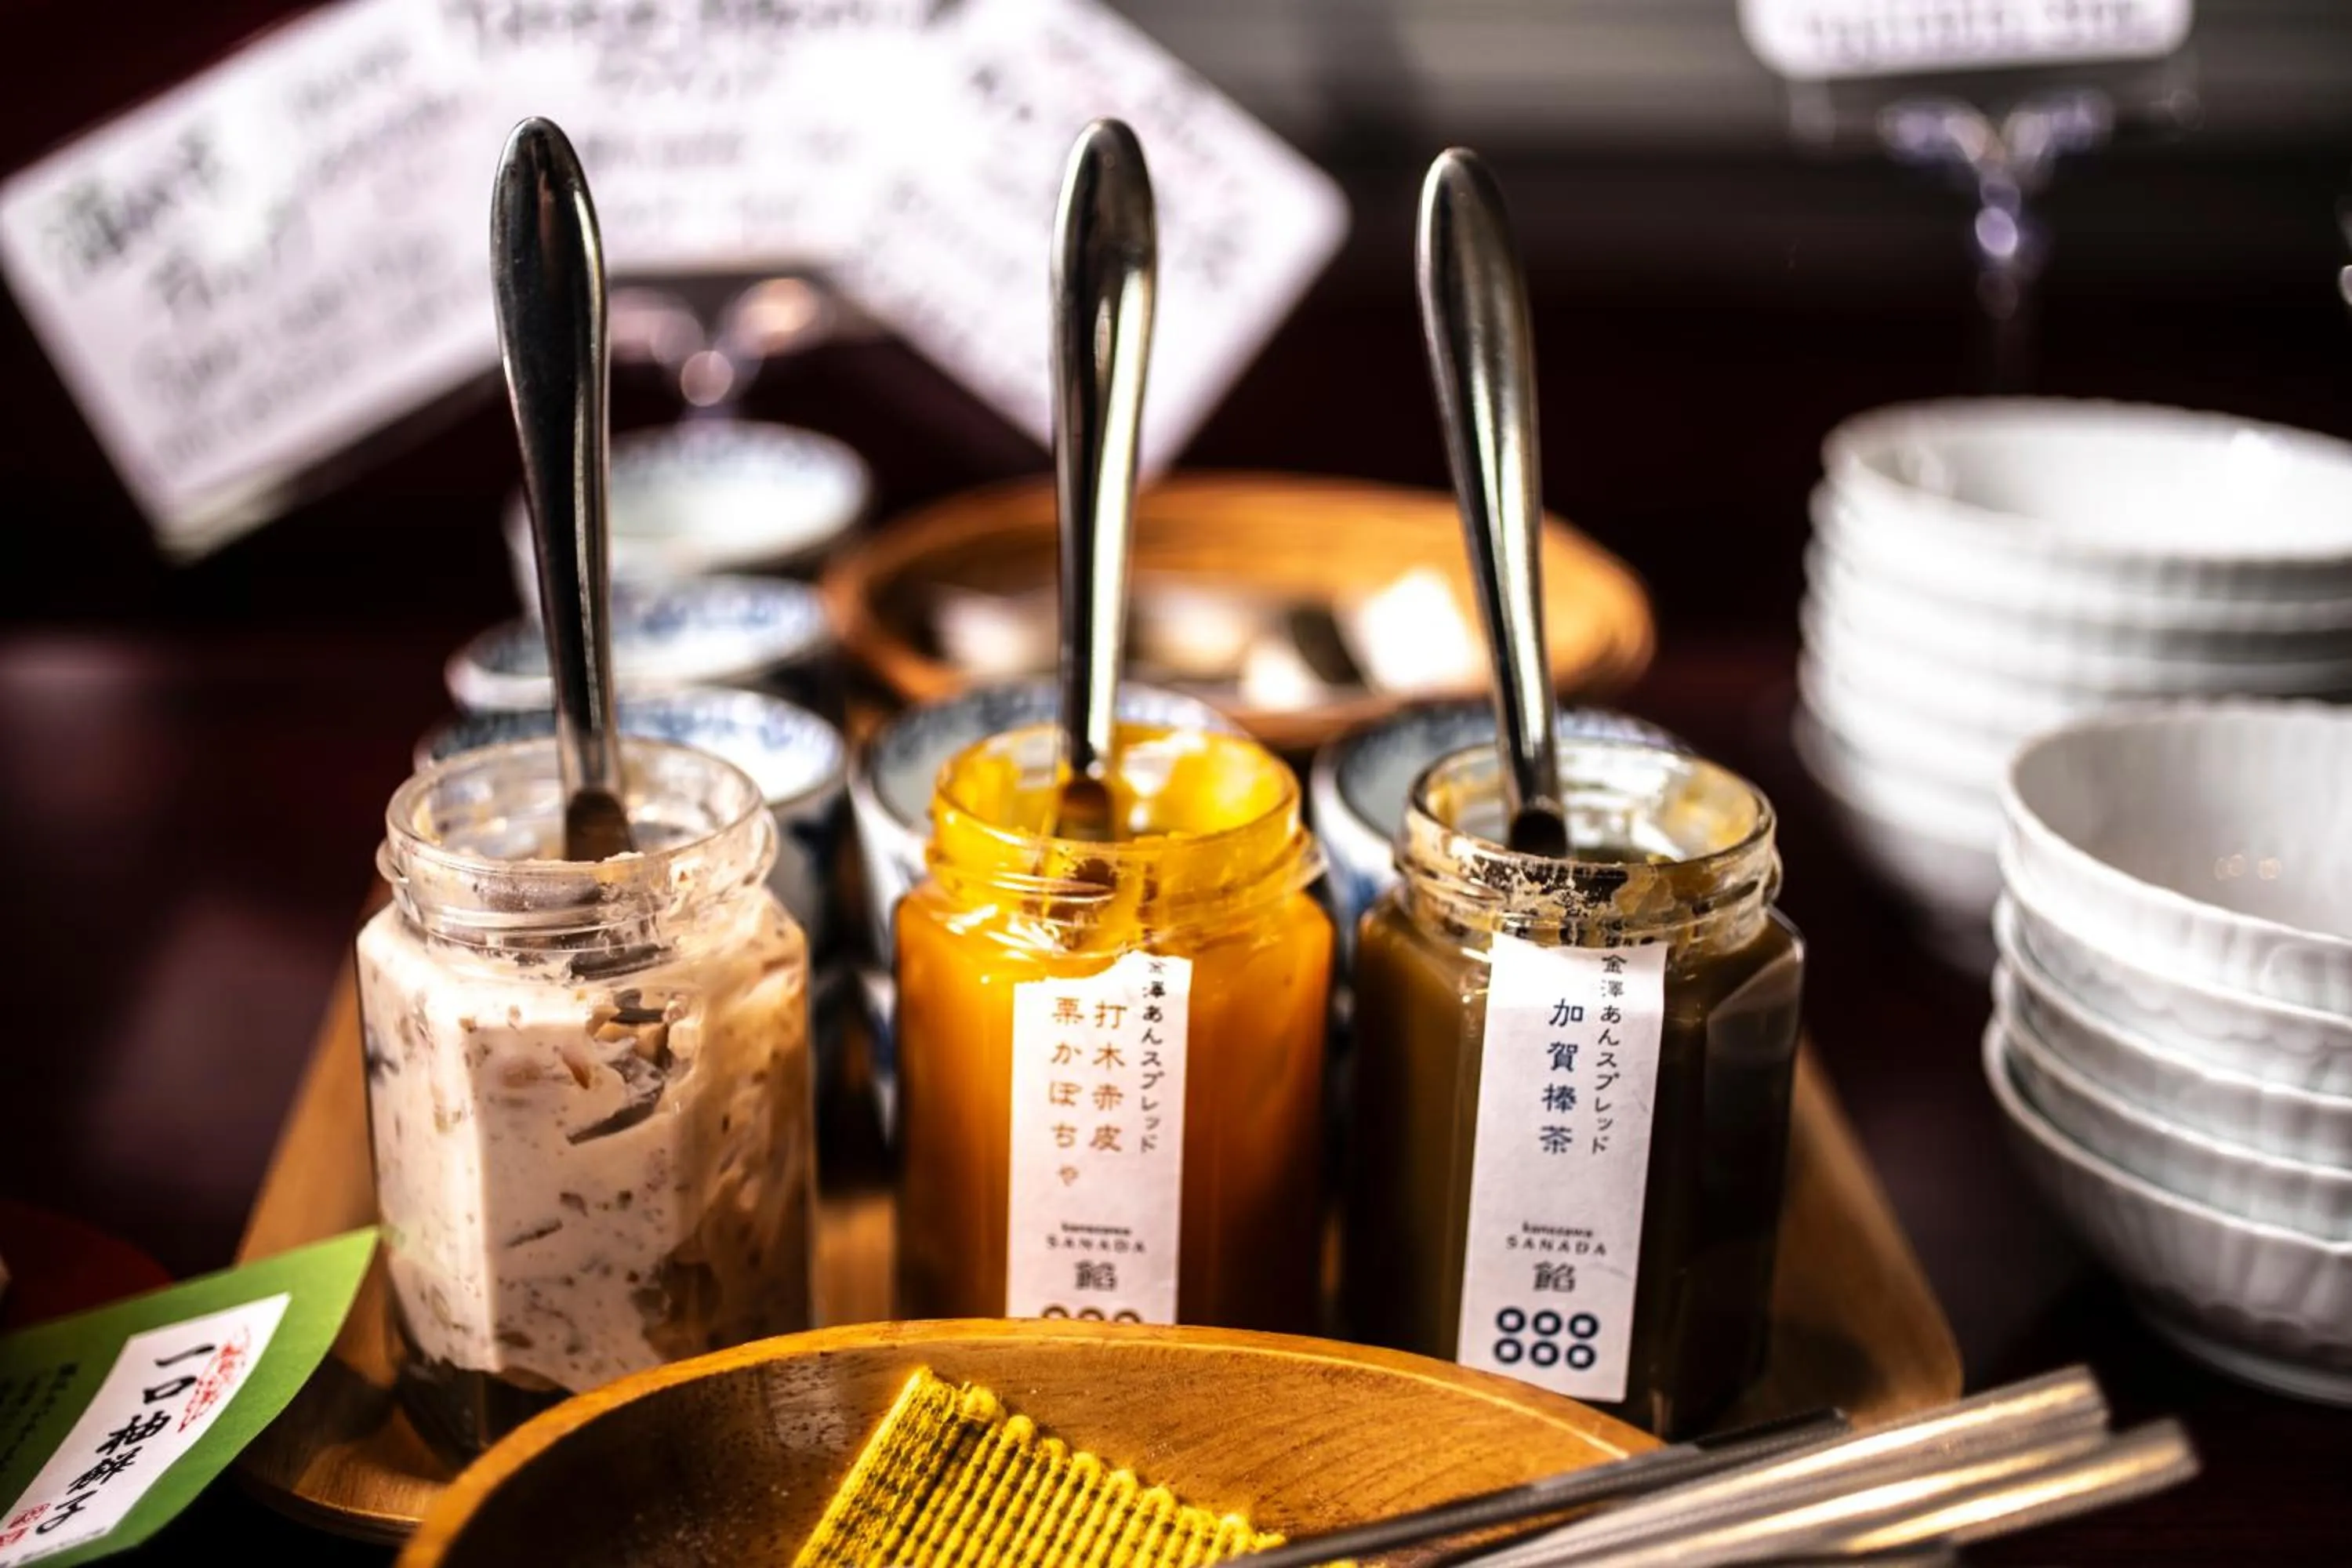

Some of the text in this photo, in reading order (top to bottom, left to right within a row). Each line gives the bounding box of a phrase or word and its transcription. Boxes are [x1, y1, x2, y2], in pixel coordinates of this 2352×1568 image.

[1049, 996, 1084, 1186] 栗かぼちゃ
[1089, 1000, 1127, 1152] 打木赤皮
[1539, 996, 1584, 1155] 加賀棒茶
[1592, 953, 1628, 1154] 金澤あんスプレッド
[1045, 1234, 1146, 1254] SANADA
[1505, 1234, 1606, 1256] SANADA
[1533, 1261, 1575, 1292] 餡
